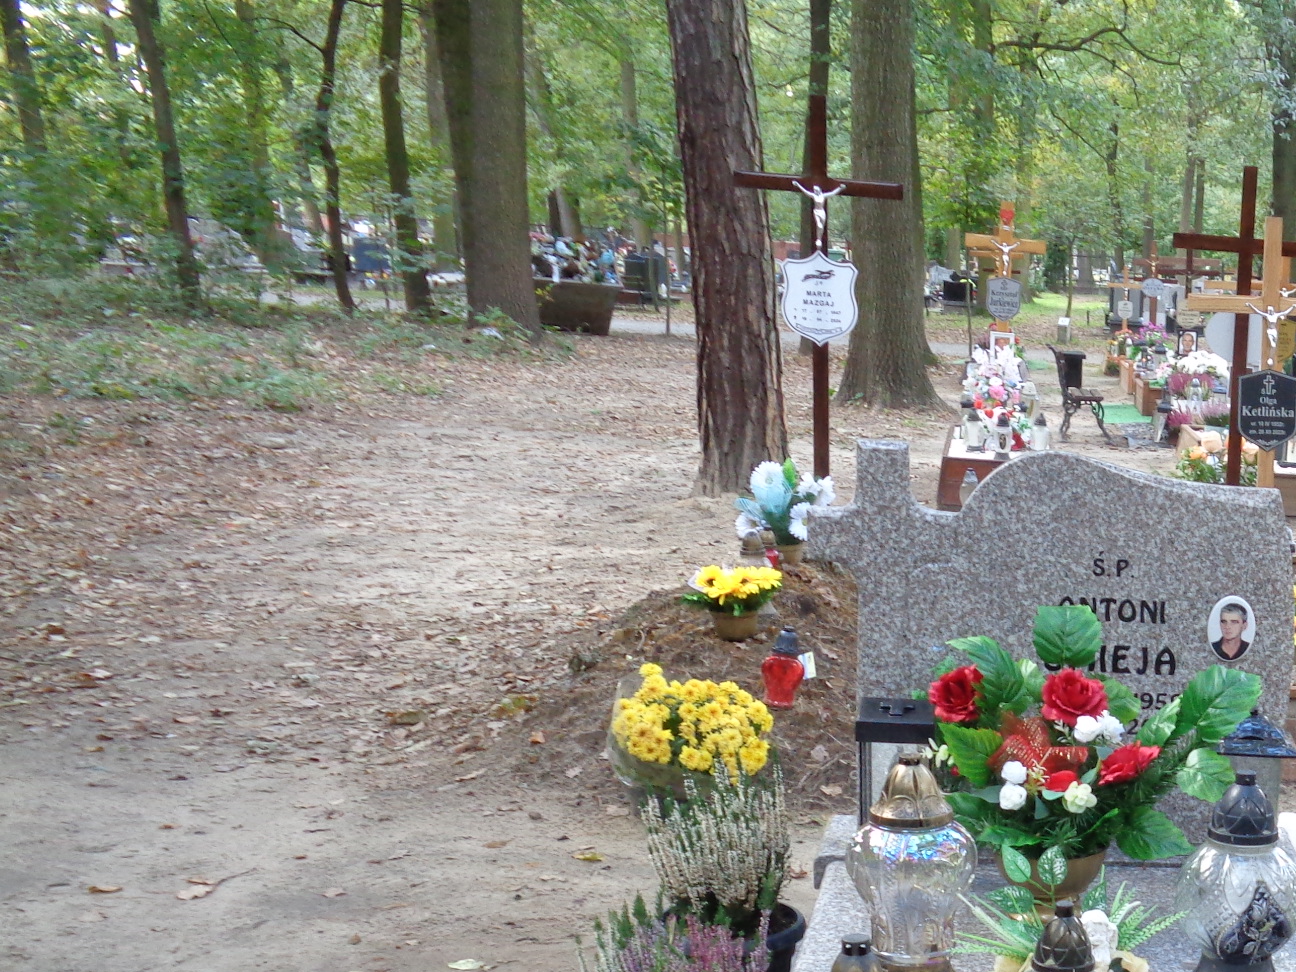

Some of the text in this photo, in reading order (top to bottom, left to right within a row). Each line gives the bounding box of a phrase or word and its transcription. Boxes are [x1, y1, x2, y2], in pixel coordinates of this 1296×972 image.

[1259, 396, 1277, 406] Olga
[1242, 405, 1295, 418] Ketlińska
[1045, 645, 1176, 676] IEJA
